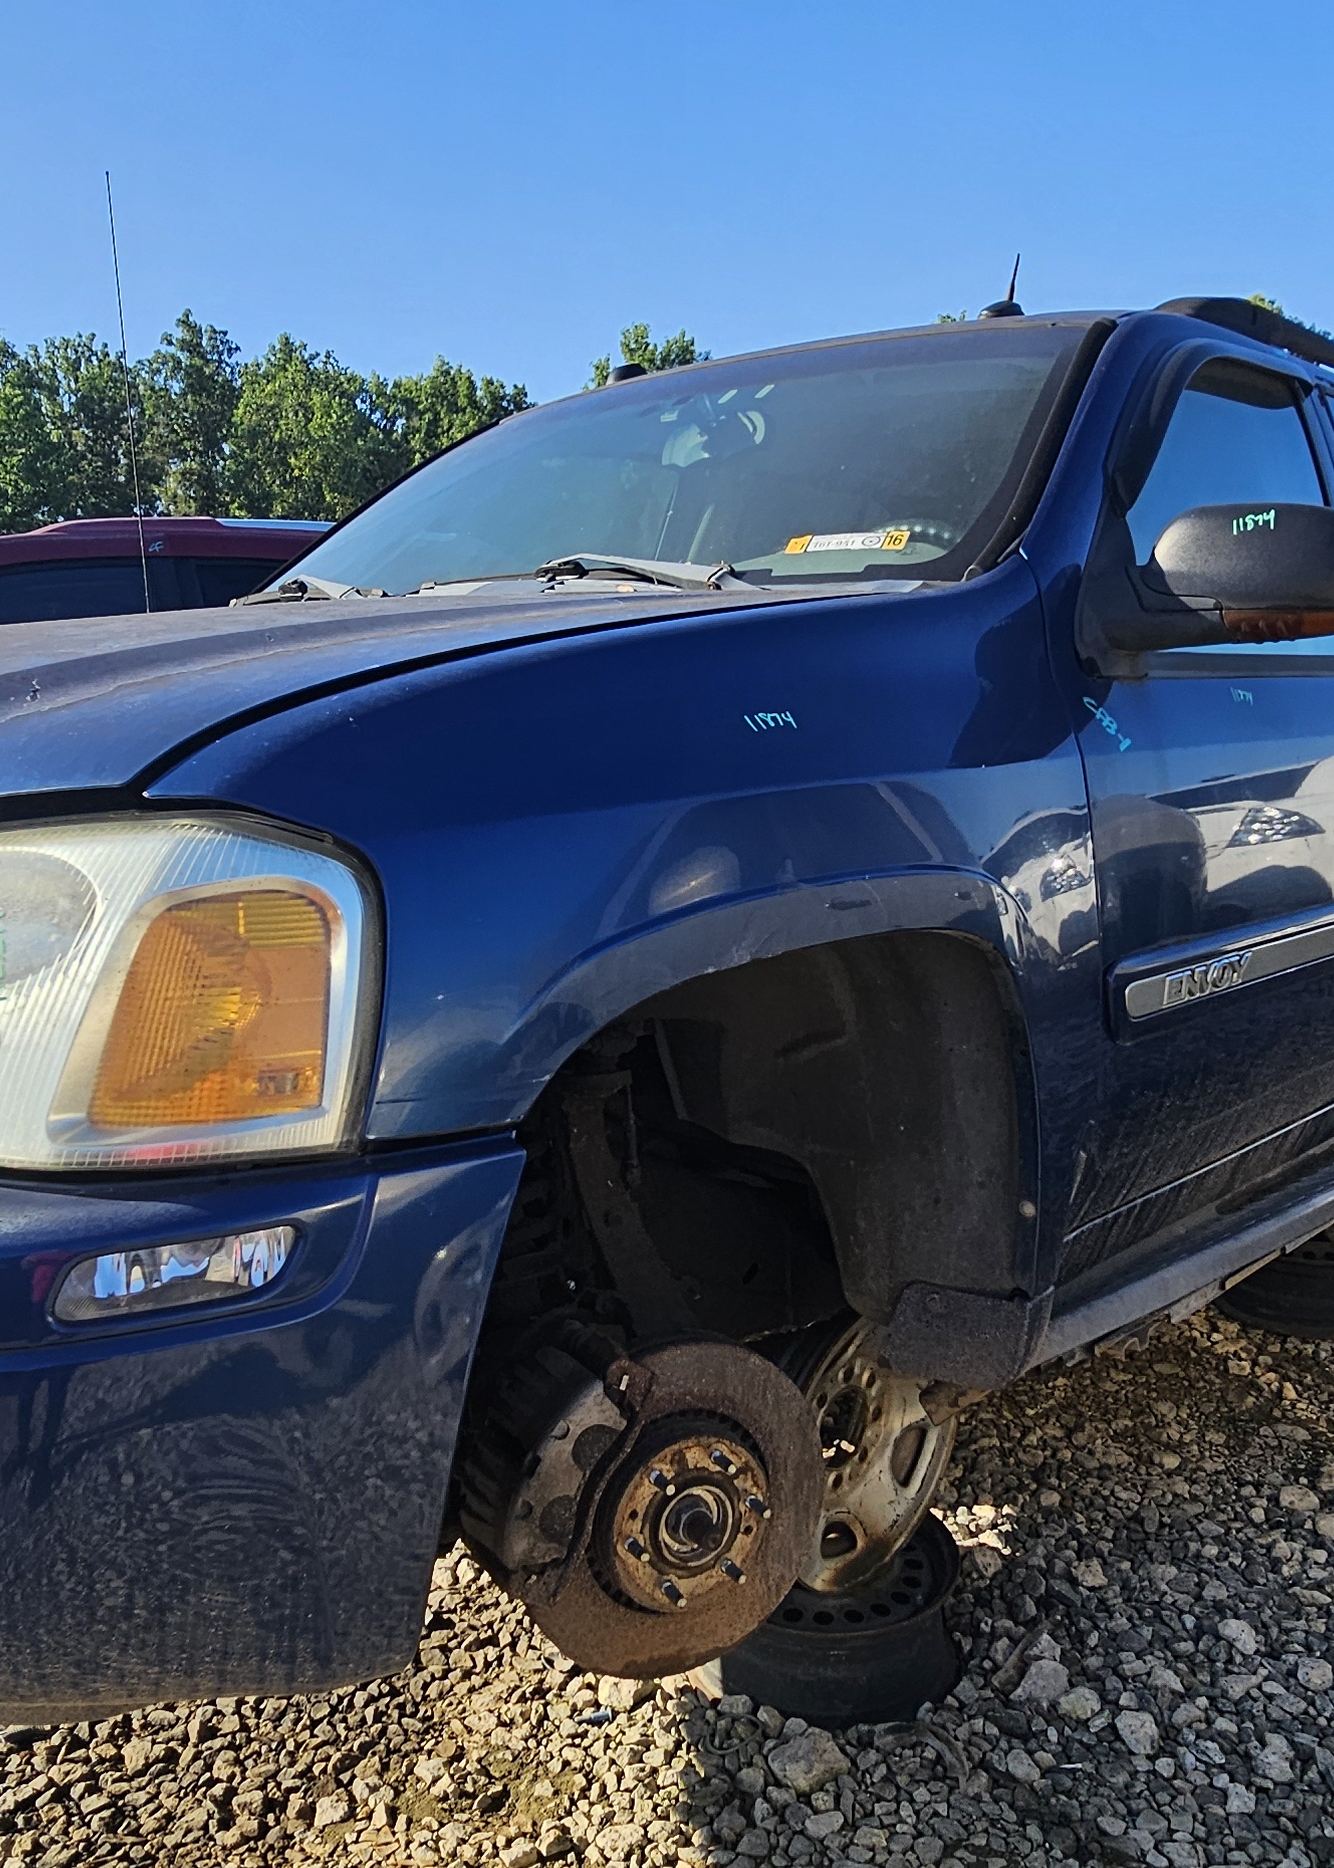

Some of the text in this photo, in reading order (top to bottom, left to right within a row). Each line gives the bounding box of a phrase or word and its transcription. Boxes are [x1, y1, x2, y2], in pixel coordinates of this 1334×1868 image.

[1232, 508, 1276, 536] 11874
[887, 533, 904, 546] 16
[743, 710, 797, 732] 11874
[1162, 951, 1252, 1008] ENVOY
